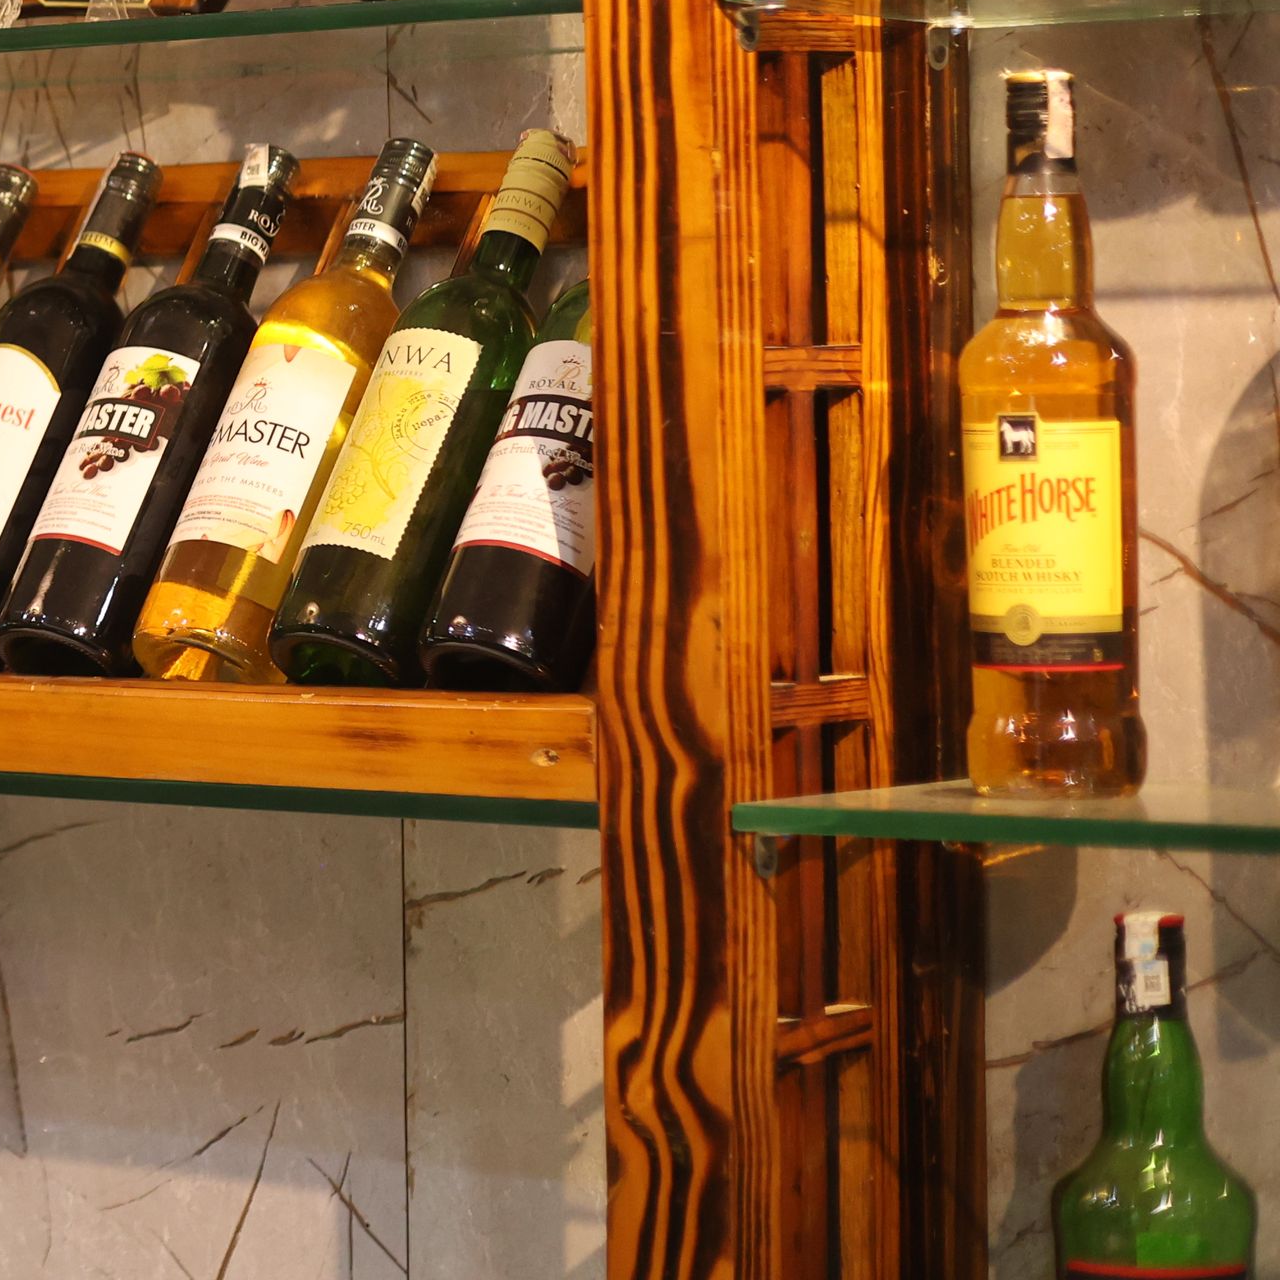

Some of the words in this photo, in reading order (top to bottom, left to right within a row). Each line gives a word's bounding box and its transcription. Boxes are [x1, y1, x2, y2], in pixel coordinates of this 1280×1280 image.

[350, 220, 376, 233] ASTER
[240, 230, 259, 247] BIG
[380, 345, 453, 373] NWA
[528, 377, 578, 391] ROYAL
[84, 403, 156, 439] ASTER
[411, 410, 449, 432] Nepal
[509, 443, 535, 455] Fruit
[237, 452, 270, 468] Wine
[221, 474, 237, 485] THE
[240, 477, 285, 498] MASTERS
[967, 483, 1017, 557] WHITE
[1020, 472, 1097, 524] HORSE
[991, 558, 1057, 569] BLENDED
[975, 571, 1018, 583] SCOTCH
[1022, 571, 1083, 583] WHISKY
